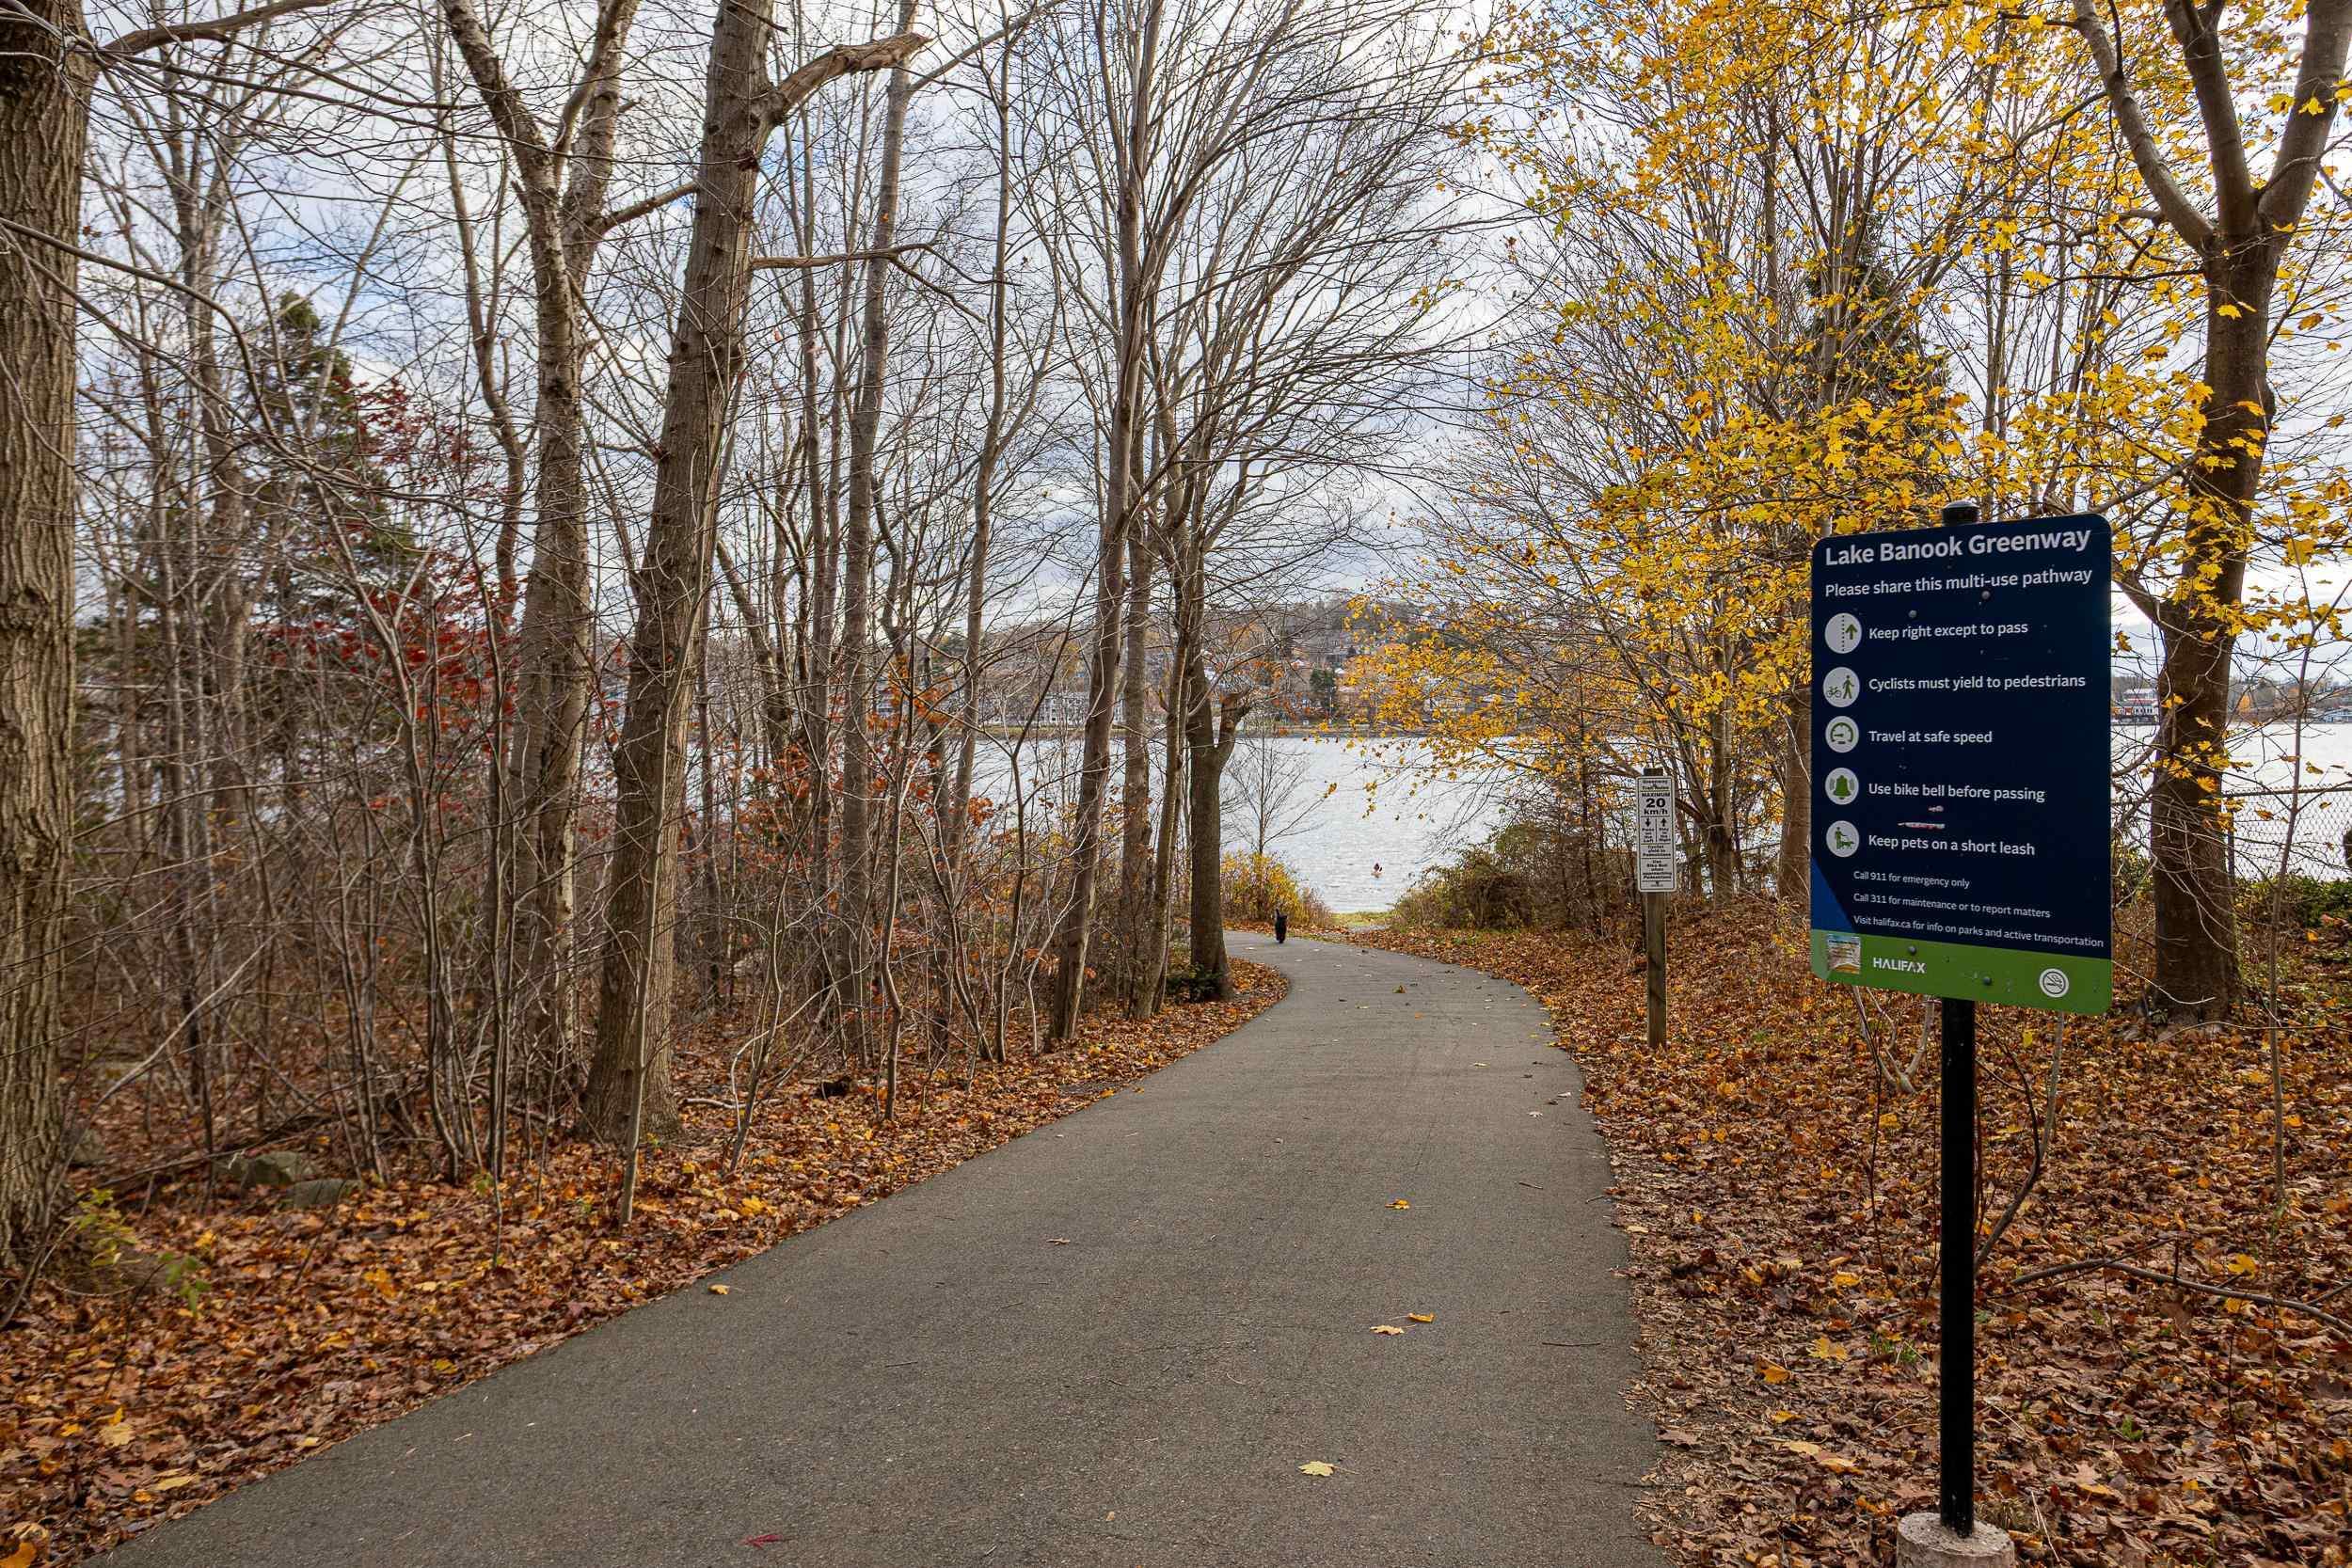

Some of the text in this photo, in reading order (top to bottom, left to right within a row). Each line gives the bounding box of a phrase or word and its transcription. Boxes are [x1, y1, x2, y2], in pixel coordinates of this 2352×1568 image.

[1826, 531, 2090, 565] Lake Banook Greenway
[1826, 569, 2092, 596] Please share this multi-use pathway
[1869, 625, 2027, 641] Keep right except to pass
[1869, 674, 2085, 691] Cyclists must yield to pedestrians
[1868, 731, 1992, 745] Travel at safe speed
[1869, 784, 2045, 802] Use bike bell before passing
[1645, 798, 1666, 808] 20
[1869, 835, 2034, 855] Keep pets on a short leash
[1853, 870, 1969, 889] Call 911 for emergency only
[1853, 893, 2050, 918] Call 311 for maintenance or to report matters
[1854, 915, 1871, 925] Visit
[1873, 916, 1912, 928] halifax.ca
[1913, 920, 1925, 930] for
[1927, 921, 1944, 931] info
[1959, 926, 1983, 936] parks
[1985, 928, 2002, 937] and
[2004, 930, 2032, 940] active
[2034, 932, 2104, 947] transportation
[1873, 958, 1925, 974] HALIFAX
